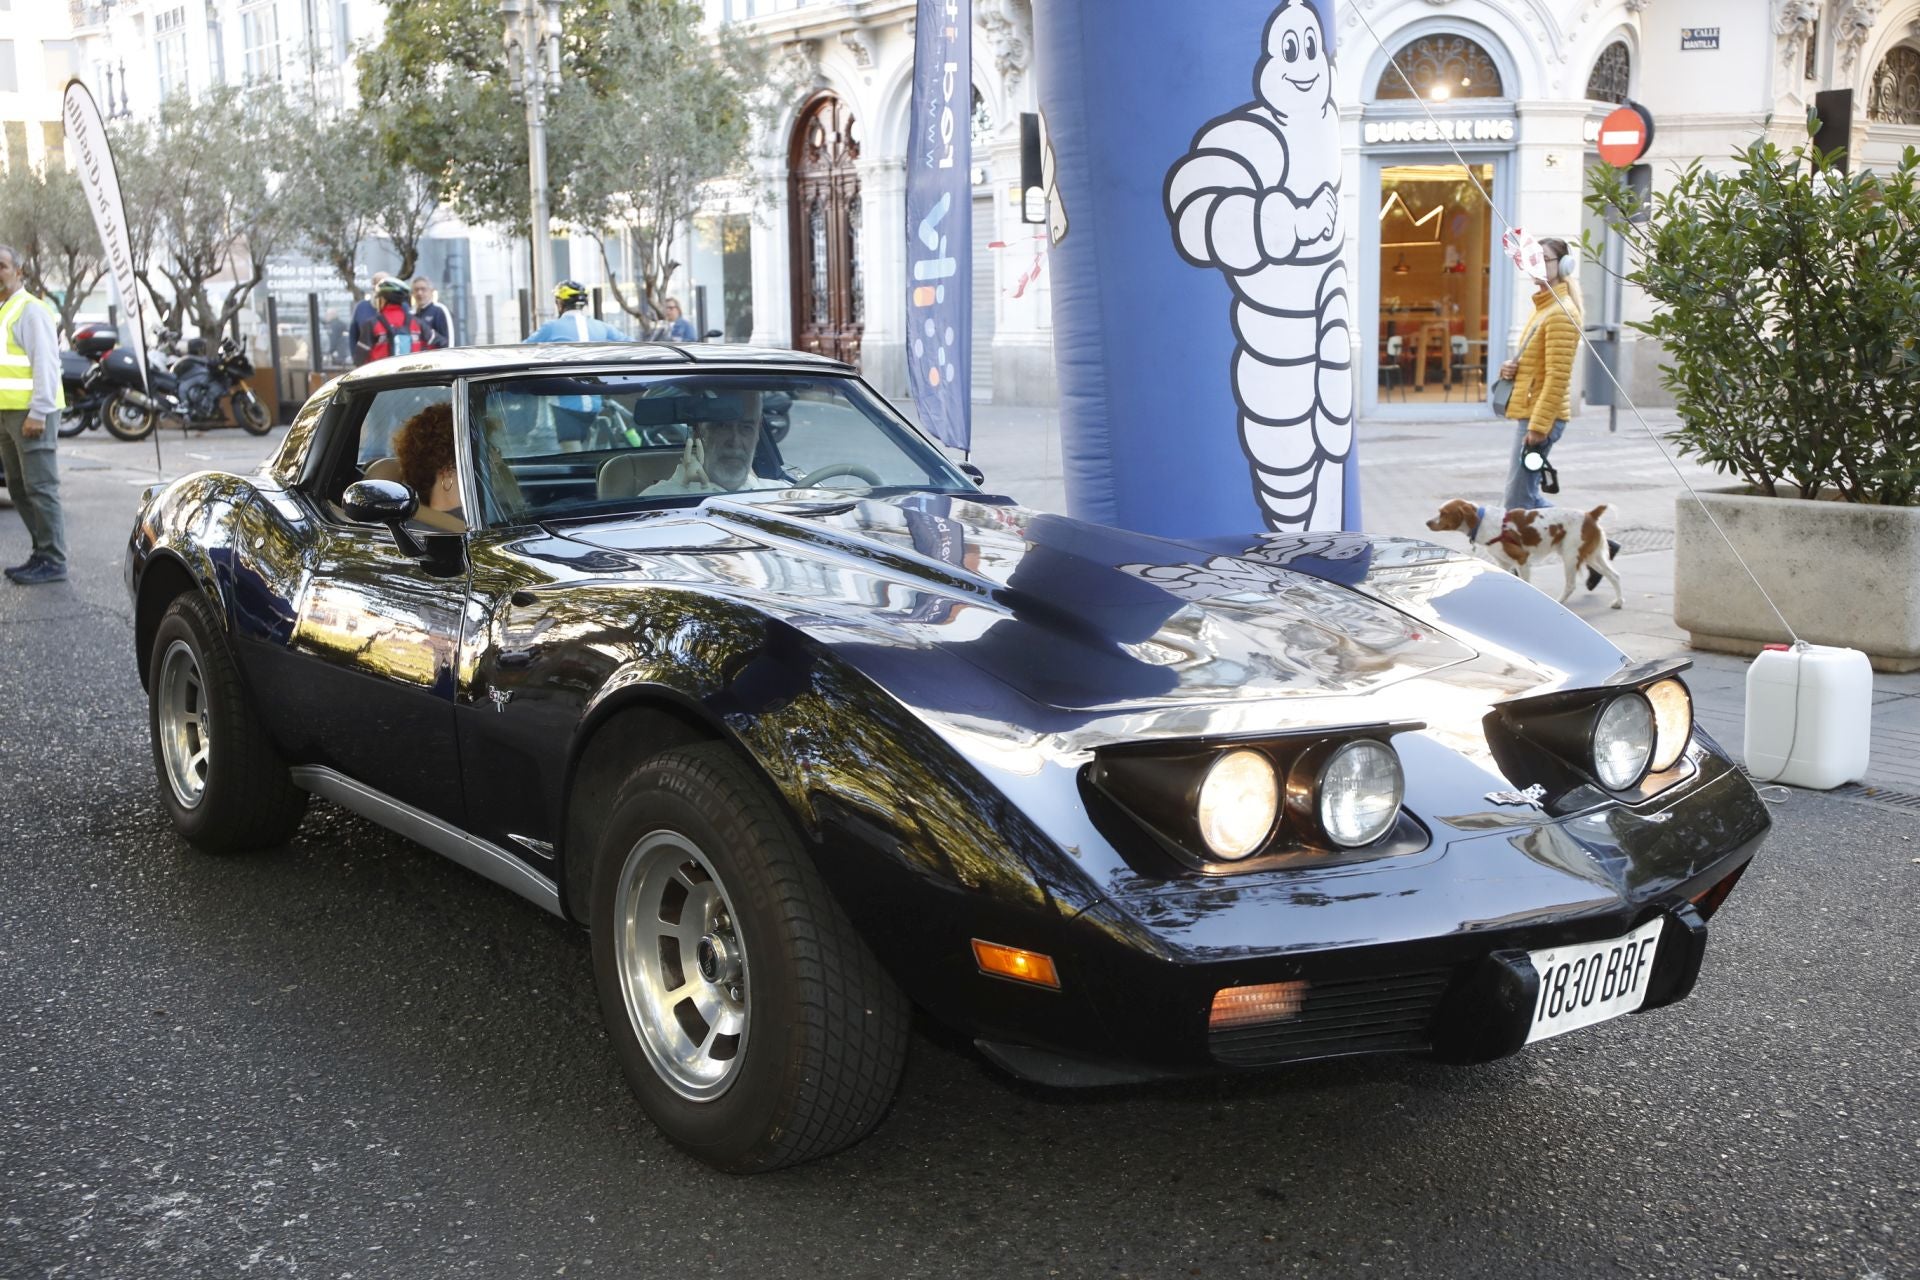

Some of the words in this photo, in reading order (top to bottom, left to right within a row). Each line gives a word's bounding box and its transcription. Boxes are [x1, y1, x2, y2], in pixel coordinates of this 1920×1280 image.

[1694, 28, 1719, 37] CALLE
[1683, 39, 1718, 49] MANTILLA
[1364, 119, 1455, 143] BURGER
[1455, 119, 1514, 141] KING
[266, 264, 297, 277] Todo
[298, 266, 312, 276] es
[267, 278, 313, 289] cuando
[658, 772, 721, 823] PIRELLI
[1537, 952, 1603, 1022] 1830
[1600, 936, 1656, 1003] BBF
